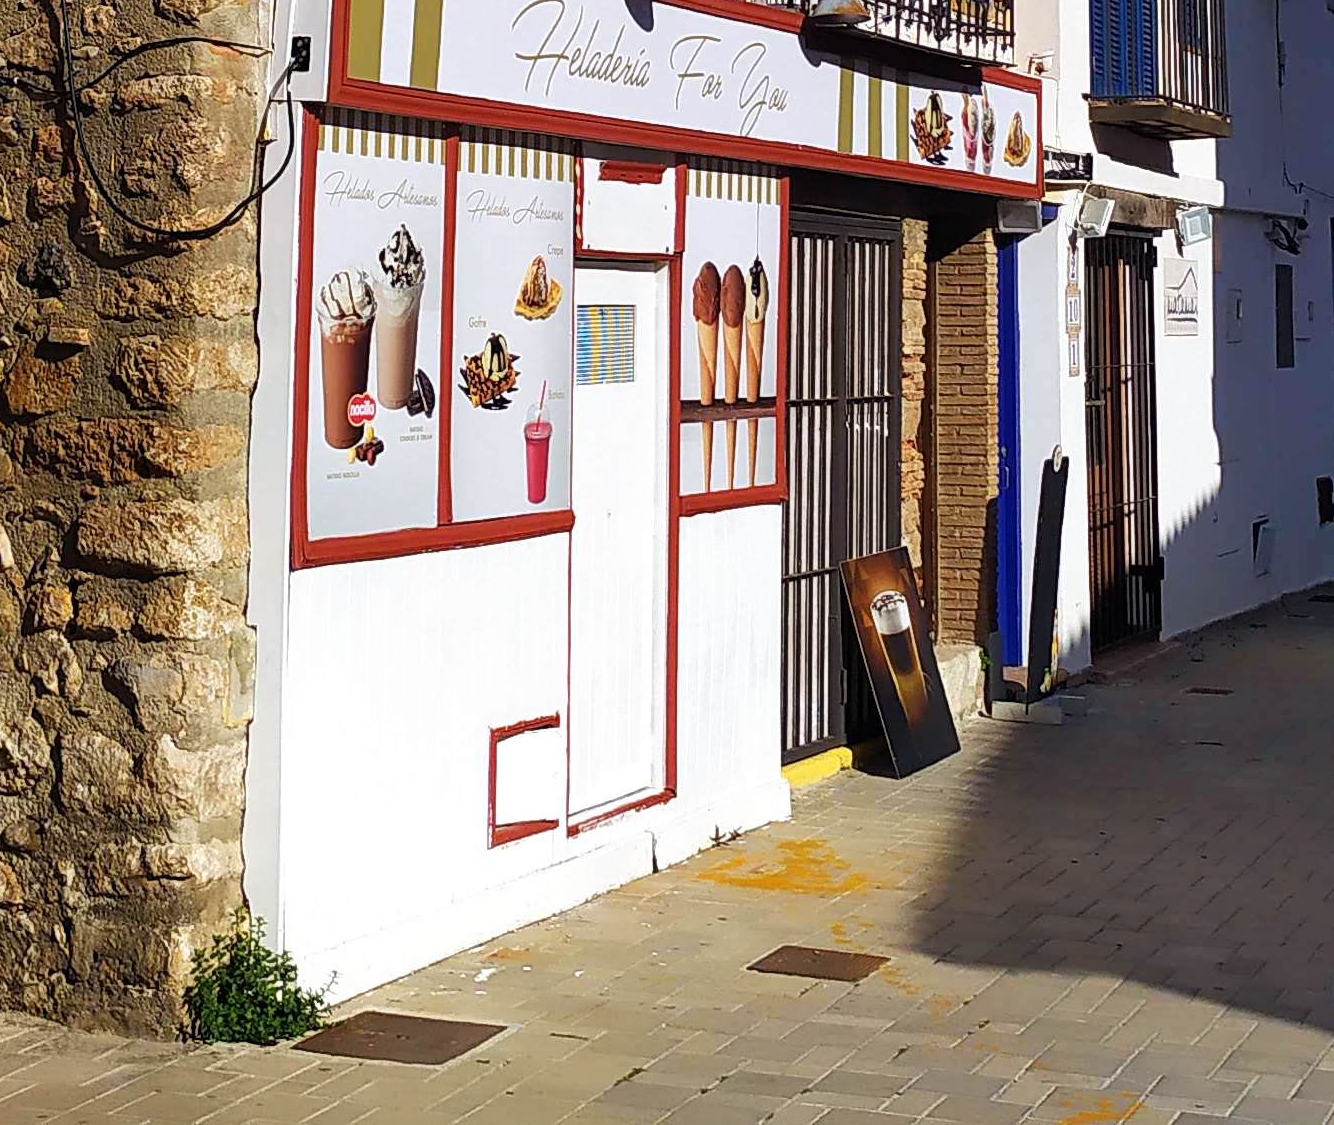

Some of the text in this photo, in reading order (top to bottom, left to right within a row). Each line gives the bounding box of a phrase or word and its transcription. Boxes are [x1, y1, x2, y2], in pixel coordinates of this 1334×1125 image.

[670, 35, 723, 110] For
[731, 42, 788, 137] You
[323, 170, 438, 210] Helados Artesanos
[466, 189, 511, 223] Helados
